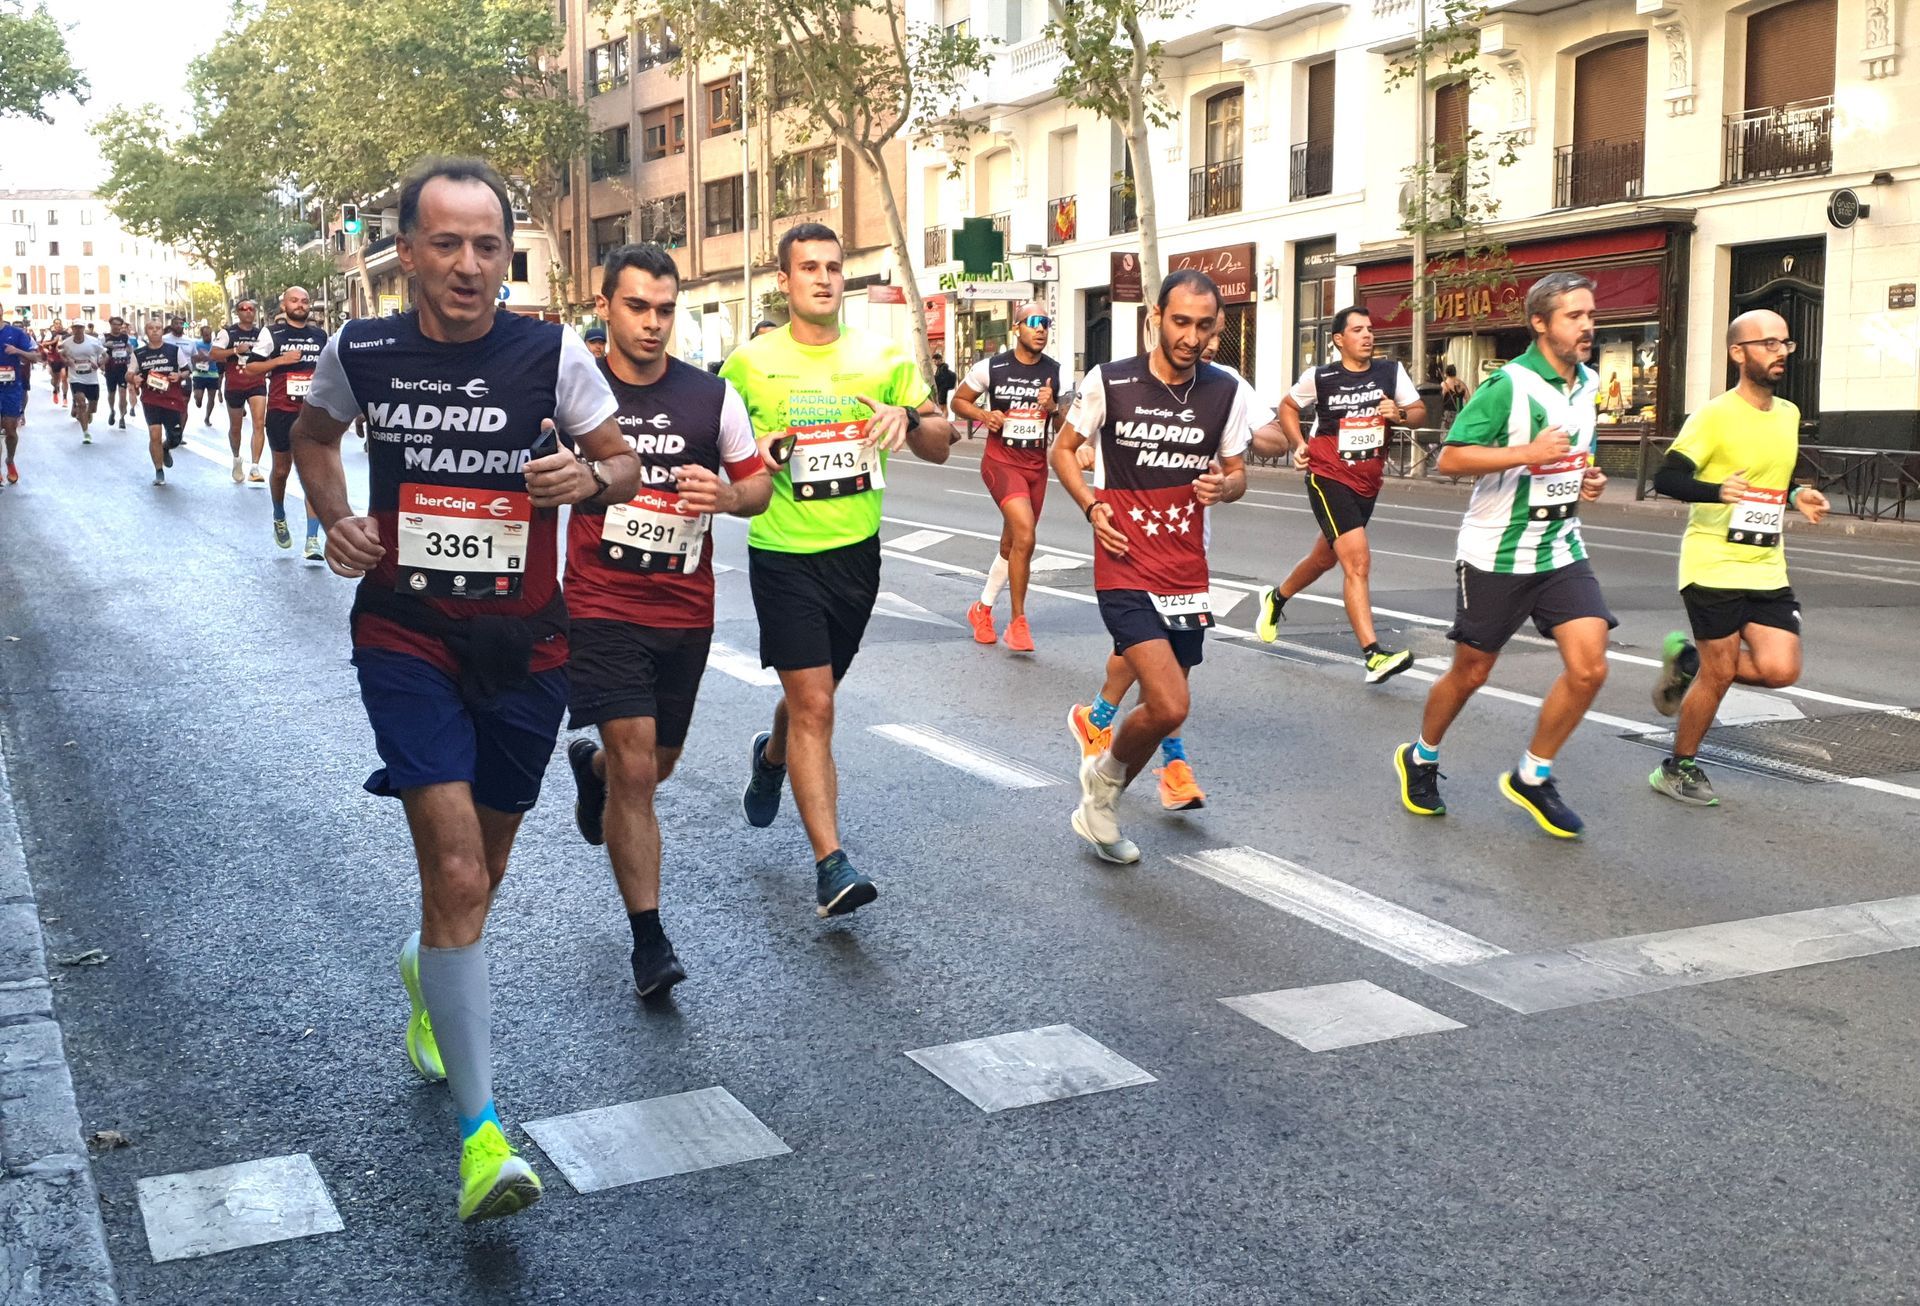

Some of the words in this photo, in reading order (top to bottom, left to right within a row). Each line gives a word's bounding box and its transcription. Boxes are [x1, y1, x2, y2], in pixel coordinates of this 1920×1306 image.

[1783, 257, 1794, 272] 17
[1219, 281, 1246, 297] CIALES
[1434, 289, 1492, 319] VIENA
[280, 343, 320, 351] MADRID
[294, 384, 310, 392] 217
[391, 377, 451, 394] iberCaja
[994, 385, 1040, 398] MADRI
[790, 396, 837, 405] MADRID
[1328, 389, 1384, 406] MADRID
[367, 402, 507, 432] MADRID
[790, 407, 842, 417] MARCHA
[1345, 407, 1381, 418] MADR
[617, 415, 643, 427] Caja
[371, 430, 401, 442] CORRE
[404, 433, 433, 444] POR
[1013, 425, 1037, 435] 2844
[1115, 421, 1205, 444] MADRID
[623, 434, 685, 454] DRID
[1350, 434, 1376, 445] 2930
[808, 452, 855, 472] 2743
[1546, 480, 1579, 497] 9356
[415, 493, 476, 512] iberCaja
[1744, 511, 1779, 526] 2902
[626, 519, 675, 543] 9291
[426, 532, 493, 559] 3361
